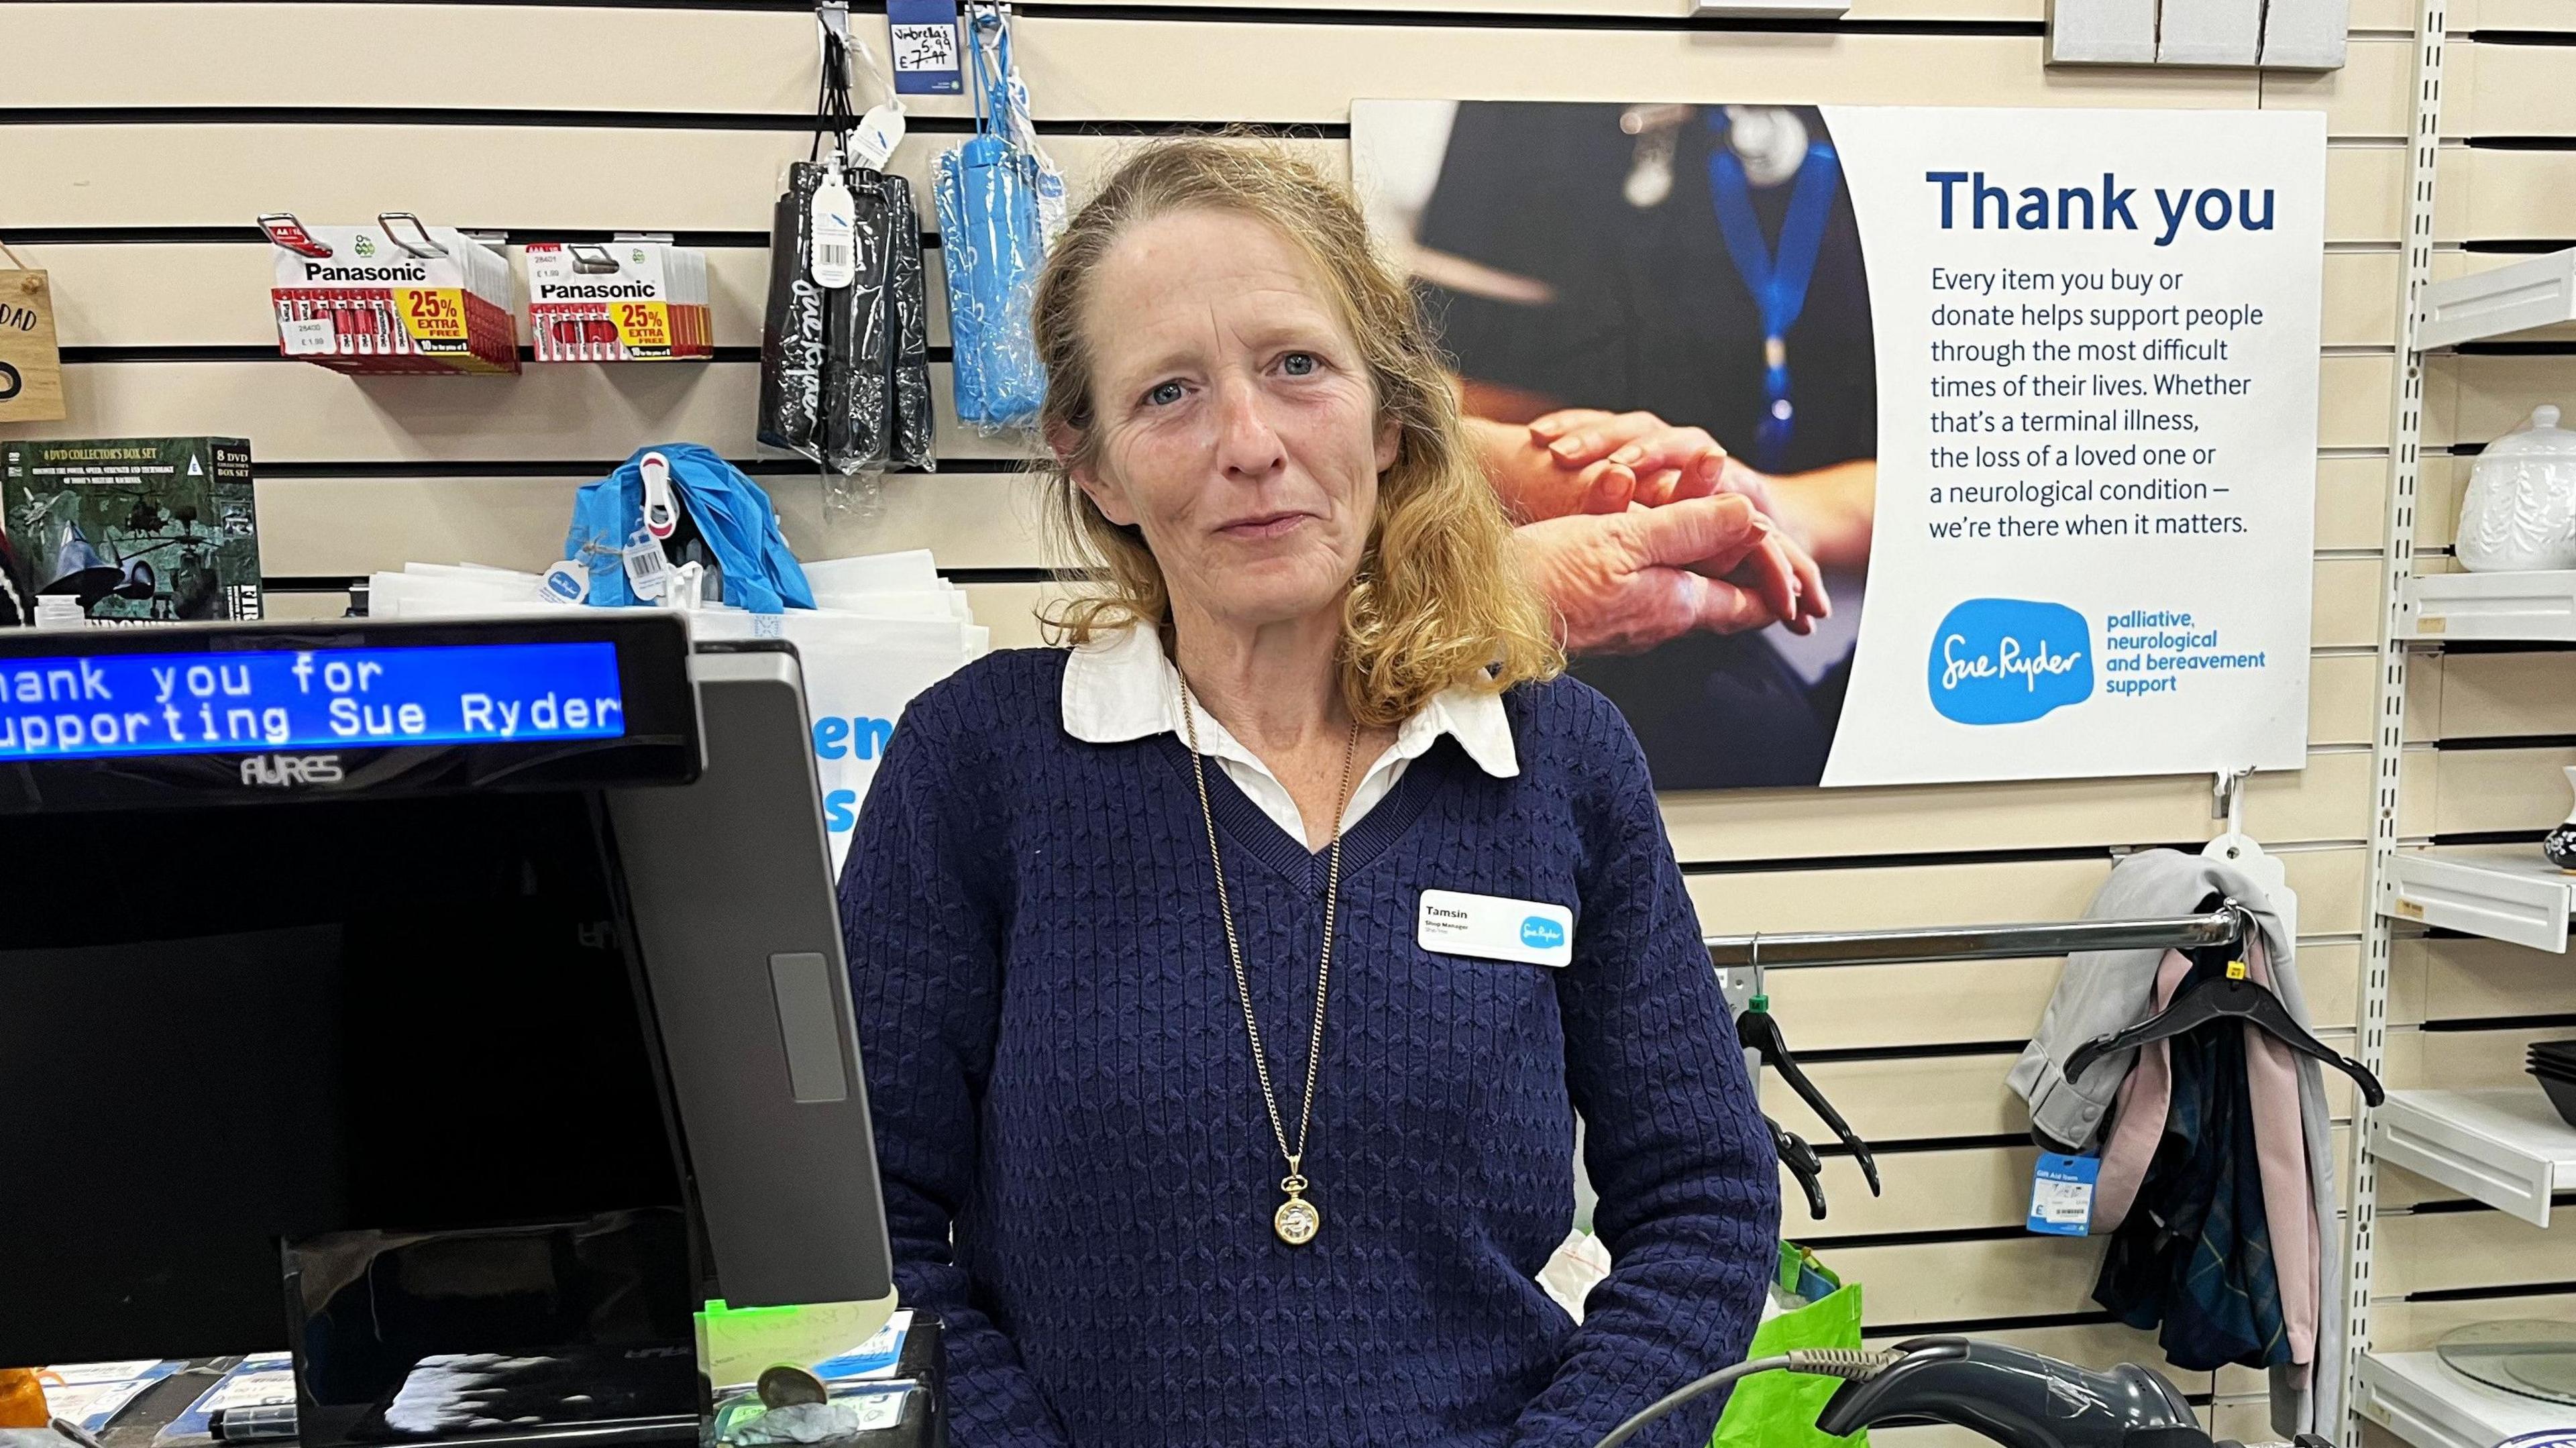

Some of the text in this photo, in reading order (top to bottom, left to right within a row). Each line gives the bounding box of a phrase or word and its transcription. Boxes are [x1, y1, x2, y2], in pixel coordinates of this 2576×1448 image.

[1925, 171, 2274, 247] Thank you
[305, 262, 426, 281] Panasonic
[1933, 268, 2184, 296] Every item you buy or
[541, 280, 655, 299] Panasonic
[409, 291, 458, 317] 25%
[621, 304, 663, 327] 25%
[417, 319, 460, 329] EXTRA
[1931, 303, 2263, 331] donate helps support people
[629, 329, 663, 337] EXTRA
[1931, 338, 2228, 368] through the most difficult
[1931, 374, 2251, 398] times of their lives. Whether
[1930, 409, 2198, 433] that’s a terminal illness,
[217, 449, 248, 462] 8 DVD
[1930, 444, 2216, 468] the loss of a loved one or
[1930, 487, 1941, 504] a
[1950, 479, 2092, 507] neurological
[2100, 478, 2207, 500] condition
[1929, 513, 2247, 538] we’re there when it matters.
[2107, 610, 2194, 632] palliative,
[2107, 629, 2217, 653] neurological
[1942, 633, 2082, 692] Sue Ryder
[2106, 650, 2265, 672] and bereavement
[152, 664, 252, 703] you
[292, 652, 382, 693] for
[2106, 675, 2176, 697] support
[329, 697, 426, 736] Sue
[460, 691, 622, 737] Ryder
[1426, 905, 1468, 919] Tamsin
[1442, 922, 1468, 930] Manager
